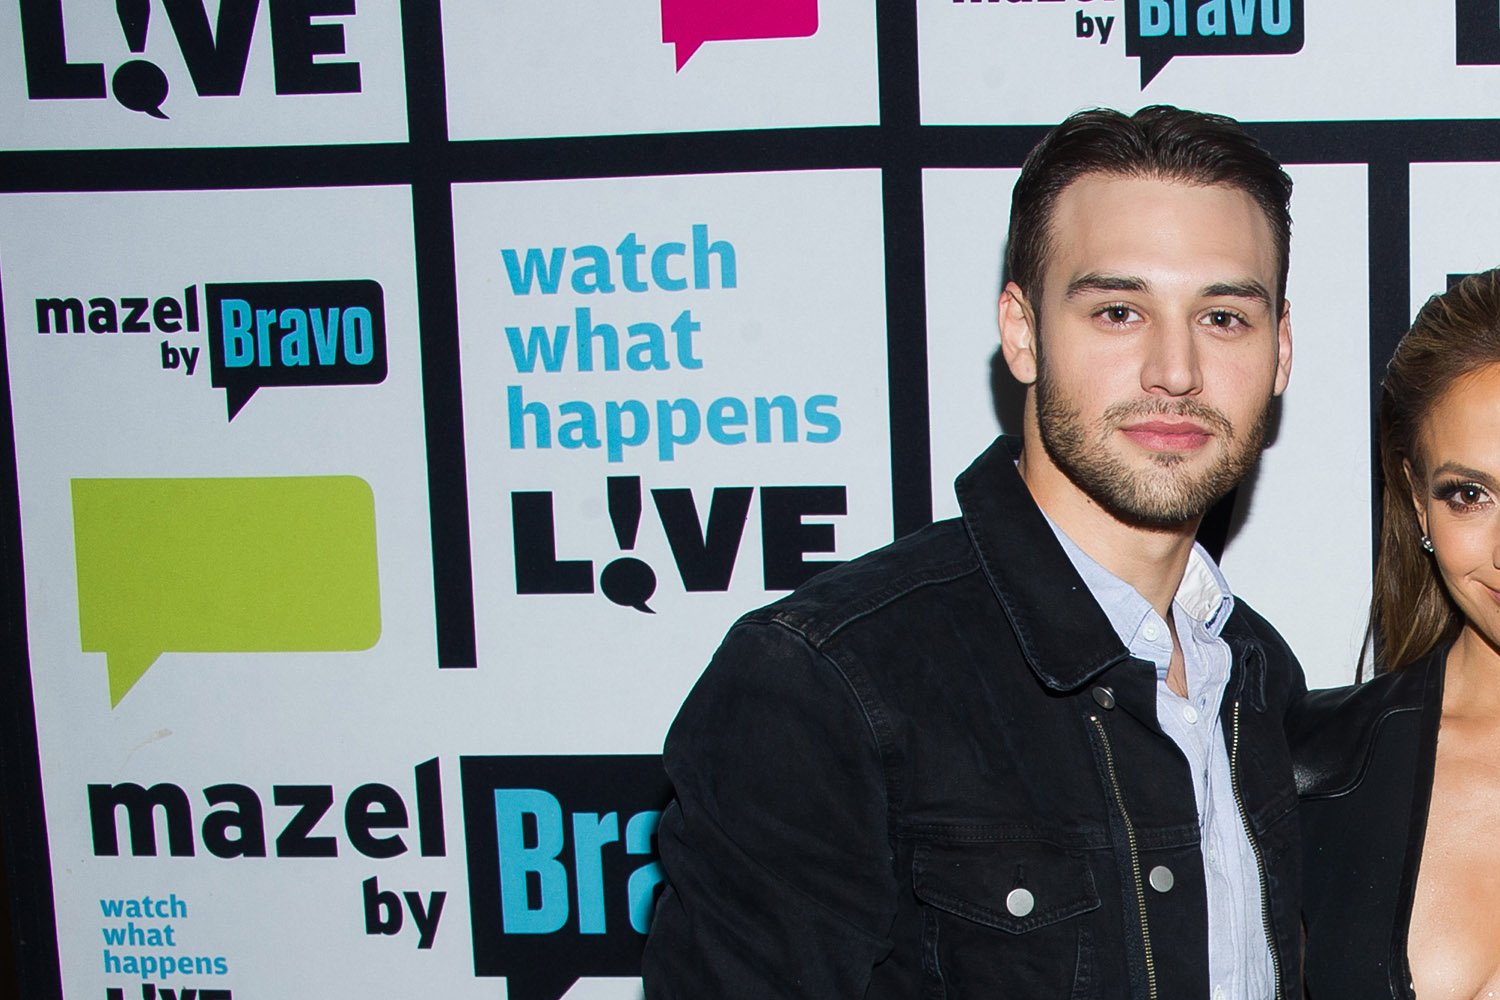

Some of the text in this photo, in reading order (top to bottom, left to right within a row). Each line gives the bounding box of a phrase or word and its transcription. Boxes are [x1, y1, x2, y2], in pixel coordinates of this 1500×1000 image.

[1076, 9, 1115, 45] by
[500, 223, 737, 296] watch
[35, 284, 199, 334] mazel
[220, 298, 374, 368] Bravo
[161, 340, 200, 376] by
[503, 306, 703, 374] what
[506, 384, 842, 463] happens
[87, 756, 446, 859] mazel
[99, 893, 188, 919] watch
[101, 921, 176, 948] what
[362, 876, 447, 949] by
[102, 948, 229, 981] happens
